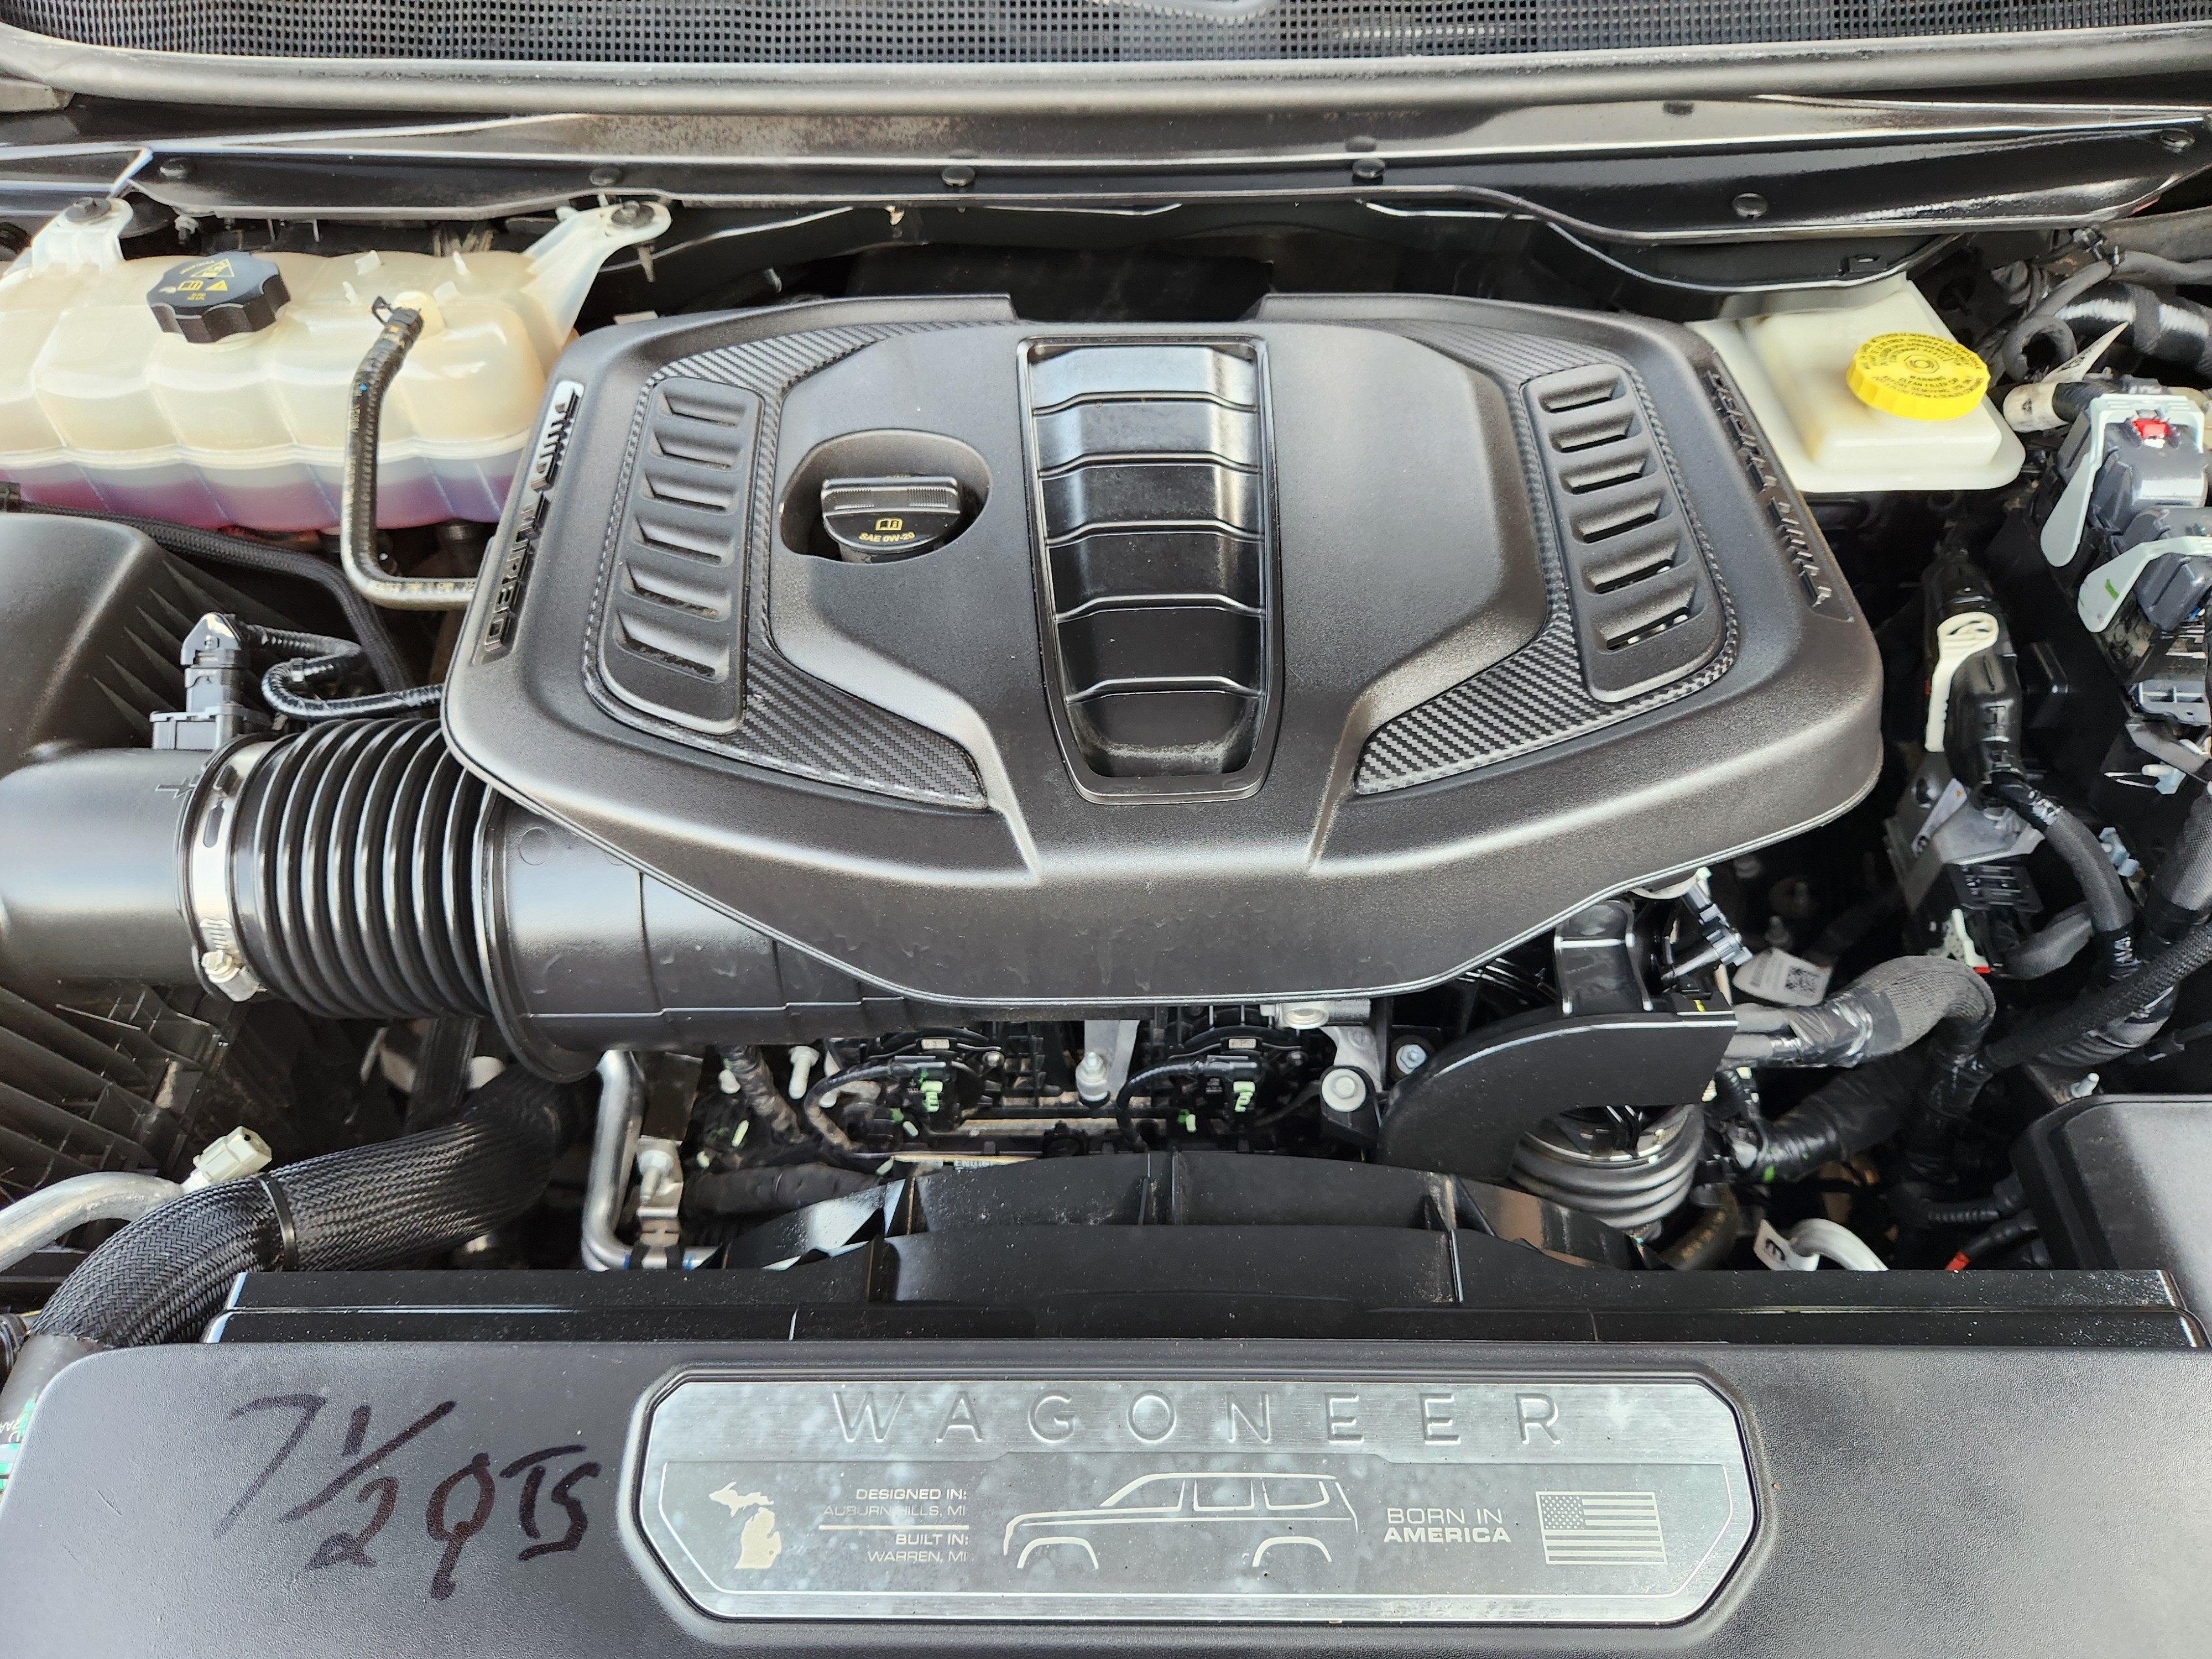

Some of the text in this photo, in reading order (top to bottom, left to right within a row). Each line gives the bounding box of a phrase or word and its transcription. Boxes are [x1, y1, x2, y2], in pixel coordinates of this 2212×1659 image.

[859, 531, 916, 542] SAE 0W-20
[833, 1390, 1562, 1445] WAGONEER
[213, 1394, 328, 1540] 7
[855, 1489, 967, 1500] DESIGNED IN:
[822, 1505, 966, 1517] AUBURN HILLS, MI
[1387, 1508, 1503, 1524] BORN IN
[895, 1534, 969, 1545] BUILT IN:
[1384, 1527, 1512, 1543] AMERICA
[867, 1551, 967, 1564] WARREN, MI
